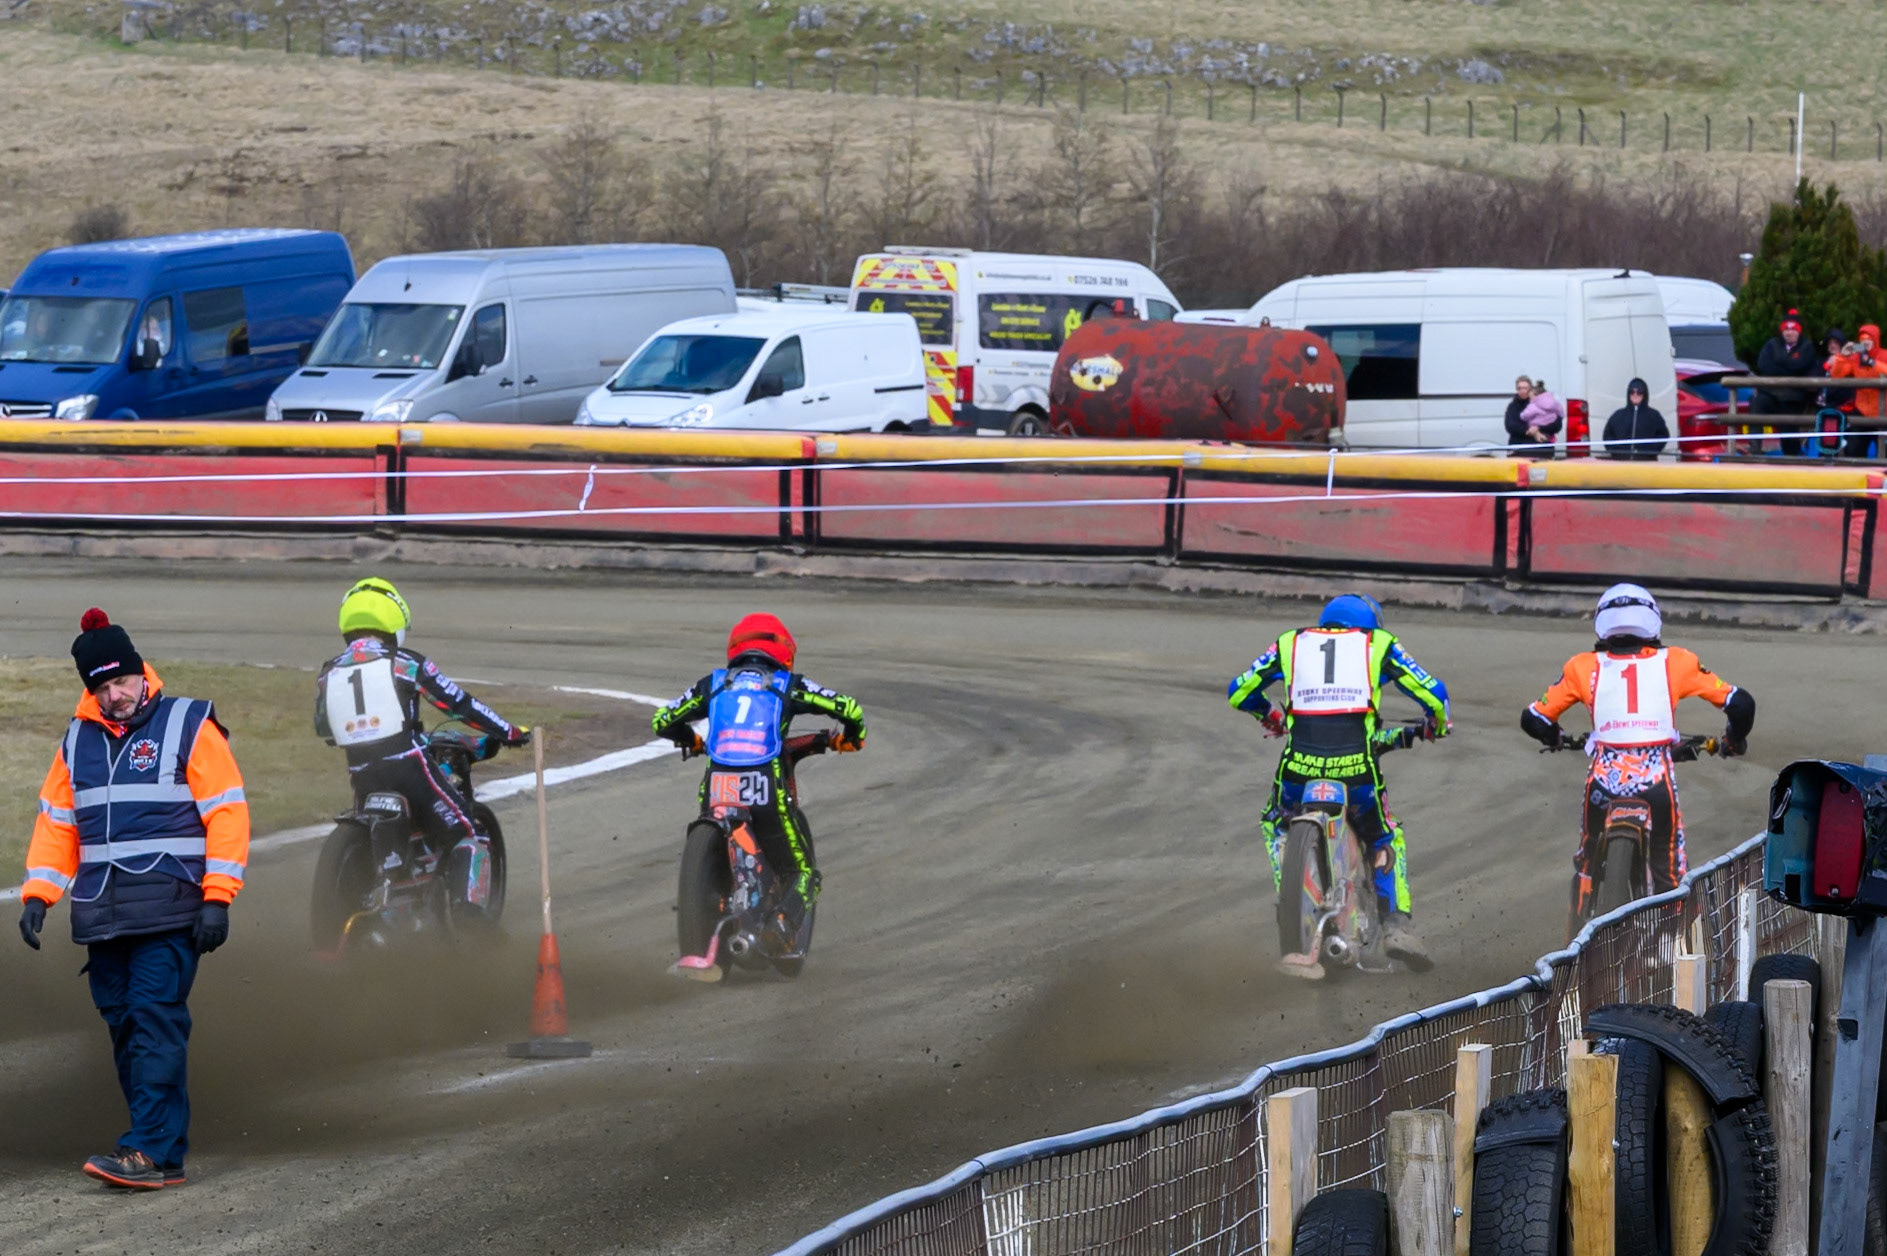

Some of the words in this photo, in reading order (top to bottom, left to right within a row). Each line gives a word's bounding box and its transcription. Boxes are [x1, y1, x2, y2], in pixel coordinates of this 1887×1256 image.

[1320, 638, 1336, 684] 1
[347, 668, 366, 716] 1
[1322, 687, 1363, 696] SPEEDWAY
[1621, 663, 1638, 714] 1
[734, 695, 752, 724] 1
[1287, 760, 1322, 777] BREAK
[1324, 763, 1367, 778] HEARTS
[1293, 751, 1325, 768] MAKE
[1325, 752, 1365, 768] STARTS
